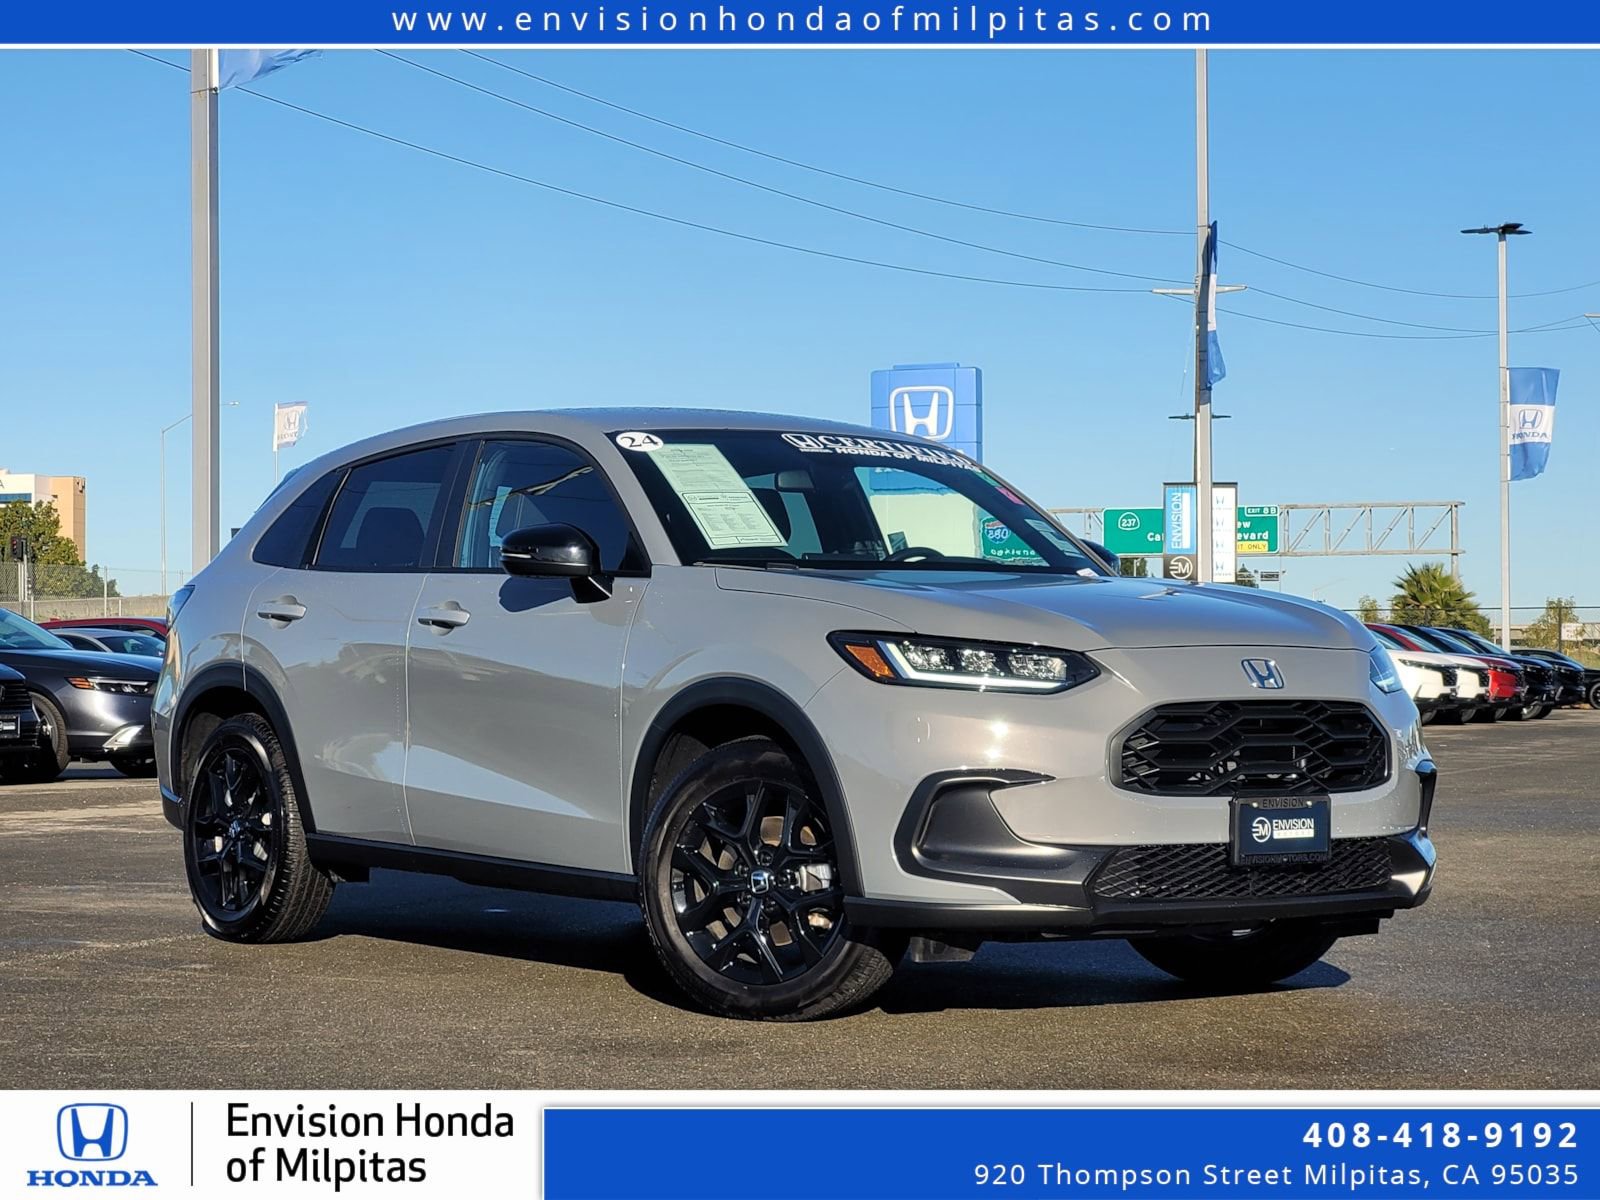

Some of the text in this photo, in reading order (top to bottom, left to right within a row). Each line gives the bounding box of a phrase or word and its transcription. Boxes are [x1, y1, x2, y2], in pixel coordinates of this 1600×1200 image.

[620, 435, 659, 448] 24
[1512, 431, 1548, 440] HONDA
[835, 447, 893, 458] HONDA
[893, 450, 914, 460] OF
[1121, 518, 1137, 527] 237
[1171, 492, 1182, 549] ENVISION
[1262, 799, 1304, 808] ENVISION
[1272, 818, 1314, 830] ENVISION
